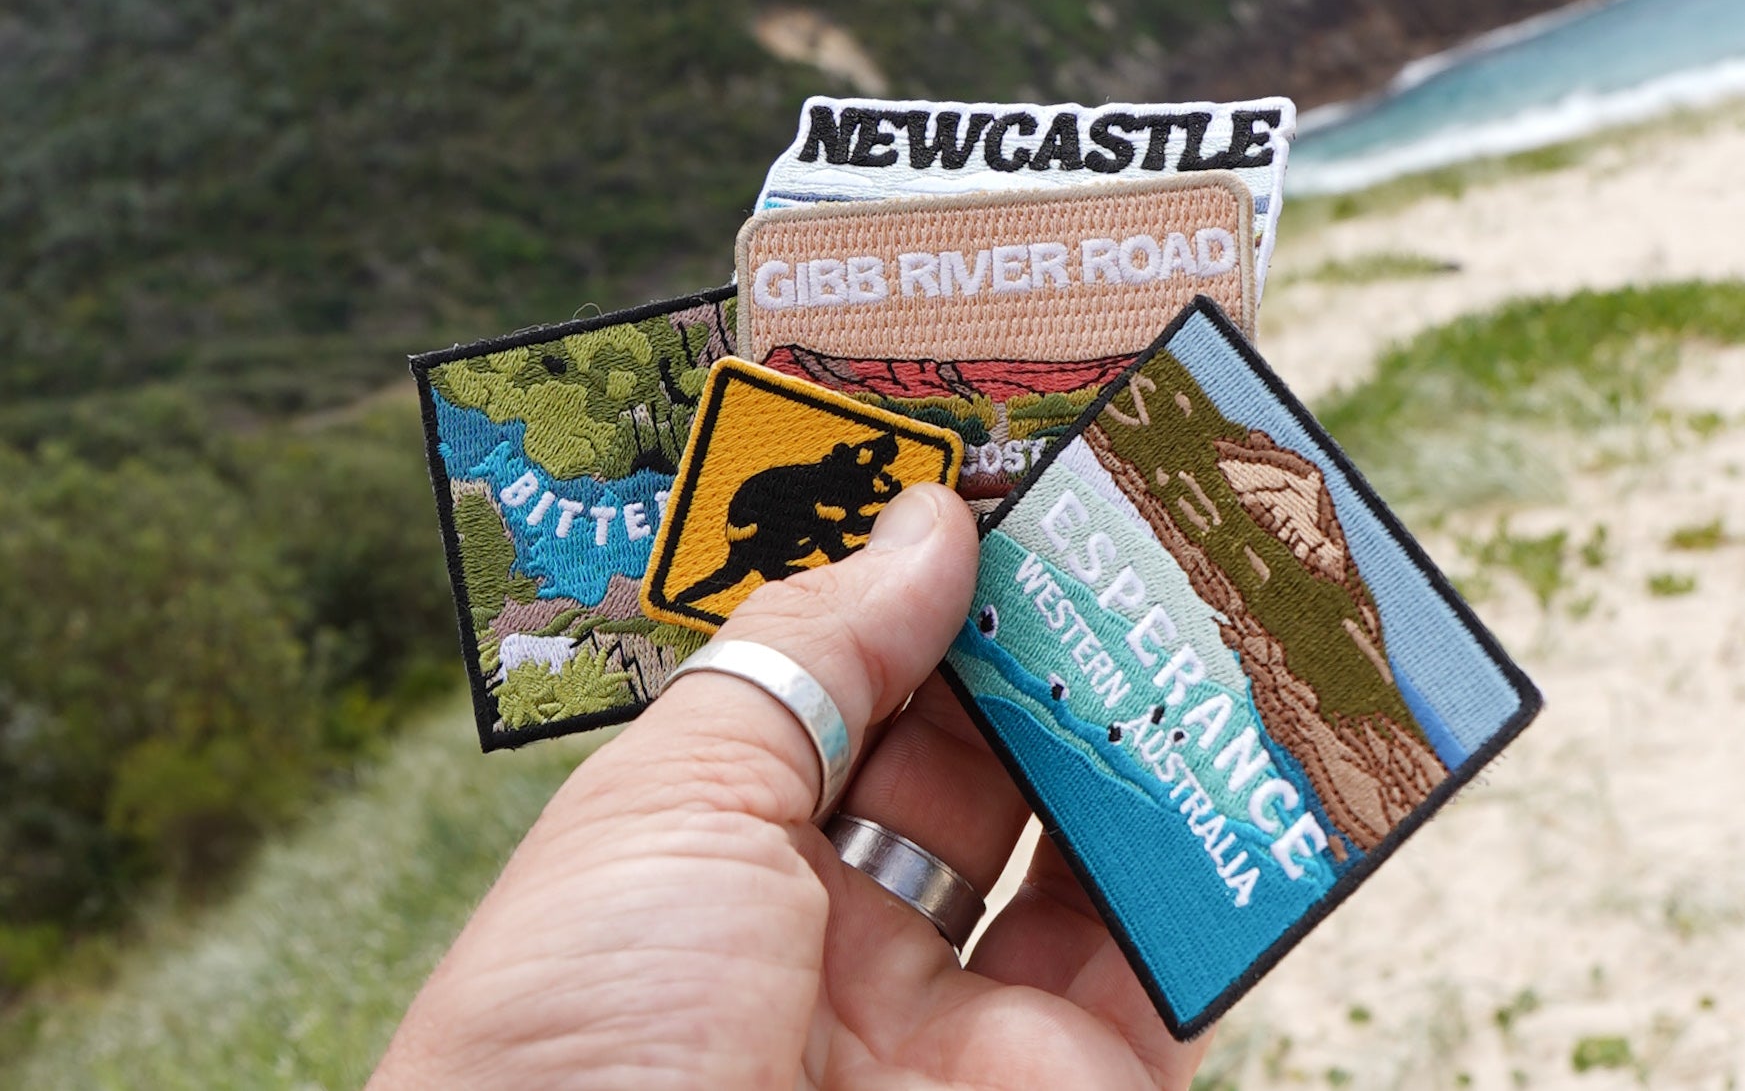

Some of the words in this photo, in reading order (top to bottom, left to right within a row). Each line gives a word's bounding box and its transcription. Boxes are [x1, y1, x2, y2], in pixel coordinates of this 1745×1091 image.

[798, 105, 1282, 173] NEWCASTLE
[753, 255, 889, 310] GIBB
[900, 241, 1071, 298] RIVER
[1081, 227, 1238, 287] ROAD
[1015, 552, 1131, 709] WESTERN
[1117, 716, 1261, 908] AUSTRALIA
[1040, 488, 1329, 881] ESPERANCE
